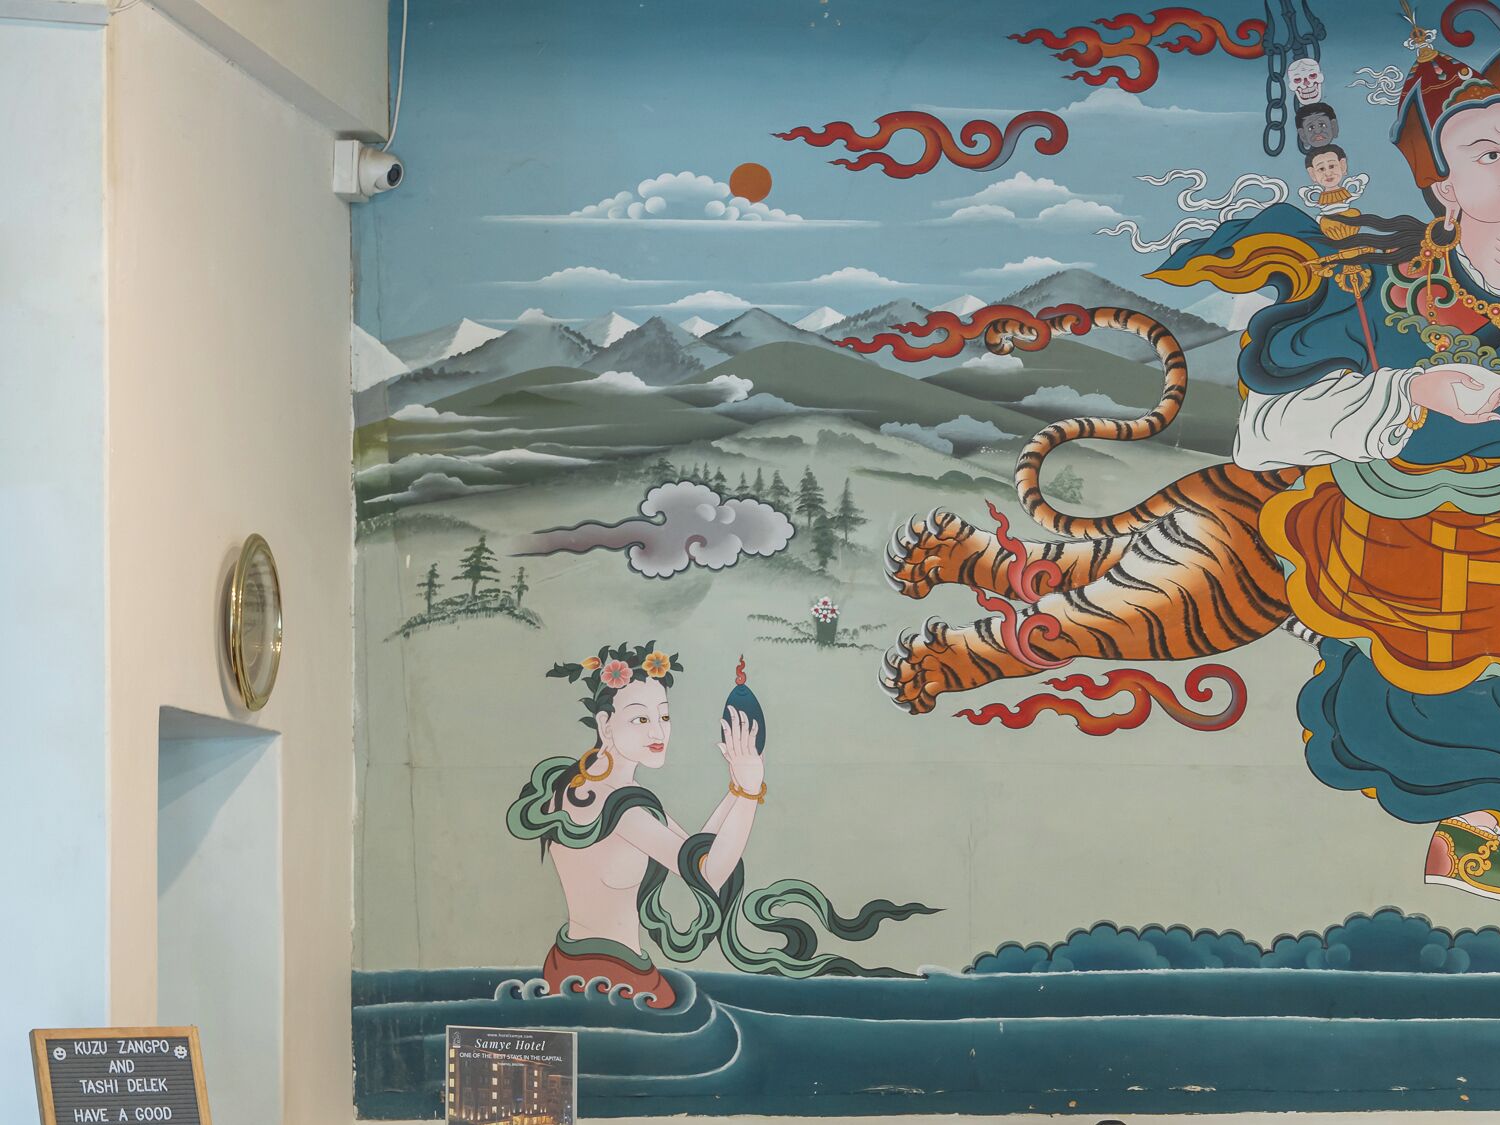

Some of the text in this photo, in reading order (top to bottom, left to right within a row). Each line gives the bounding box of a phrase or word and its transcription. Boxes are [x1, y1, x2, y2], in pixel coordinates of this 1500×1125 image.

[74, 1039, 169, 1055] KUZU ZANGPO
[475, 1039, 546, 1051] Samye Hotel
[109, 1060, 135, 1073] AND
[80, 1078, 168, 1094] TASHI DELEK
[74, 1107, 172, 1122] HAVE A GOOD
